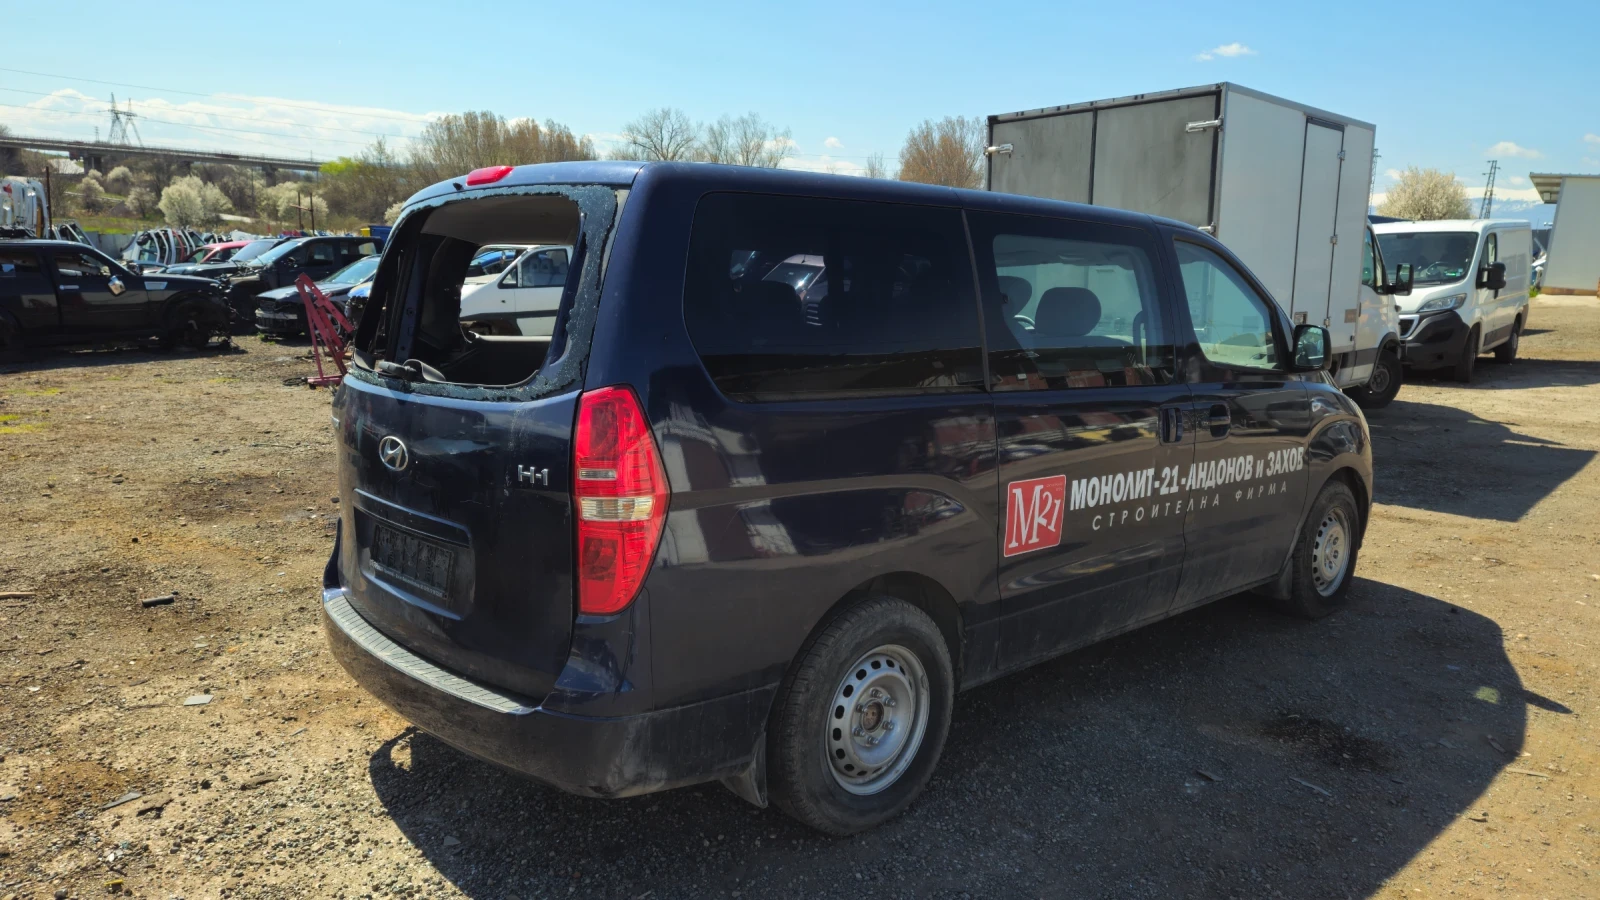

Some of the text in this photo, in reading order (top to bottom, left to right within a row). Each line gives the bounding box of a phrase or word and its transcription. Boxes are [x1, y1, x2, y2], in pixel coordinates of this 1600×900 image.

[517, 464, 549, 486] H-1
[1266, 447, 1304, 476] ЗАХОВ
[1092, 481, 1287, 531] СТРОИТЕЛНА ФИРМА
